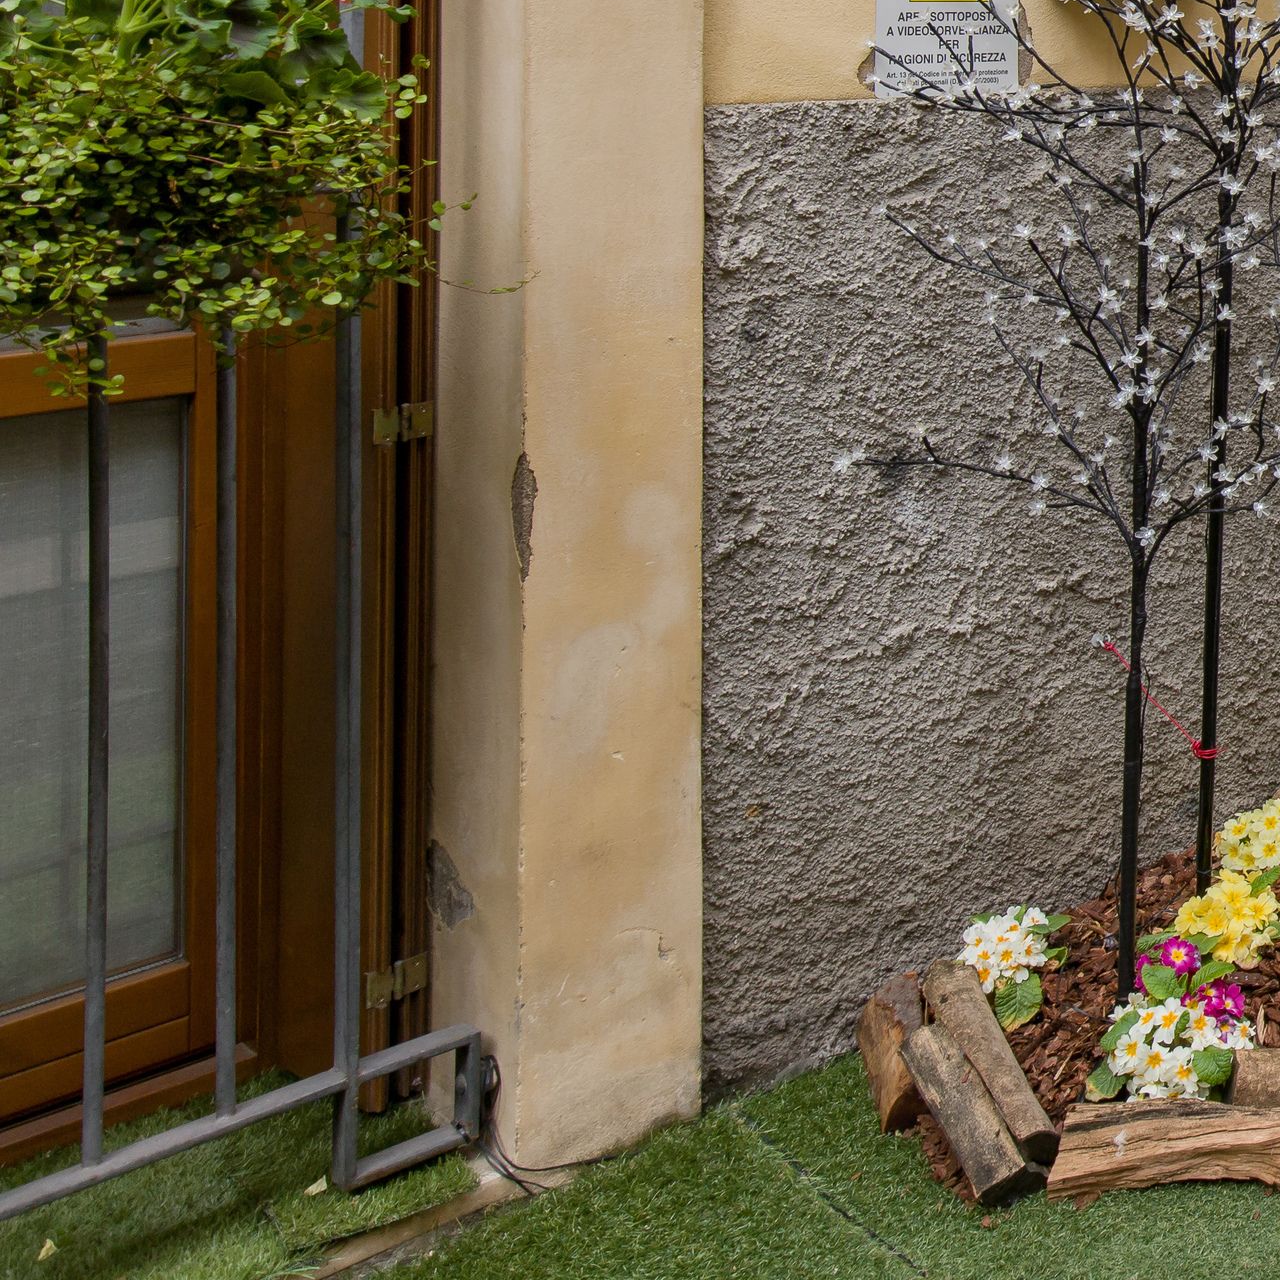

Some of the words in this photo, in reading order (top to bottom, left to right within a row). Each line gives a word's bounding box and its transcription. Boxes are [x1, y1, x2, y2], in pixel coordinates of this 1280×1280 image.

[898, 11, 926, 22] ARE
[886, 26, 894, 36] A
[939, 40, 960, 50] PER
